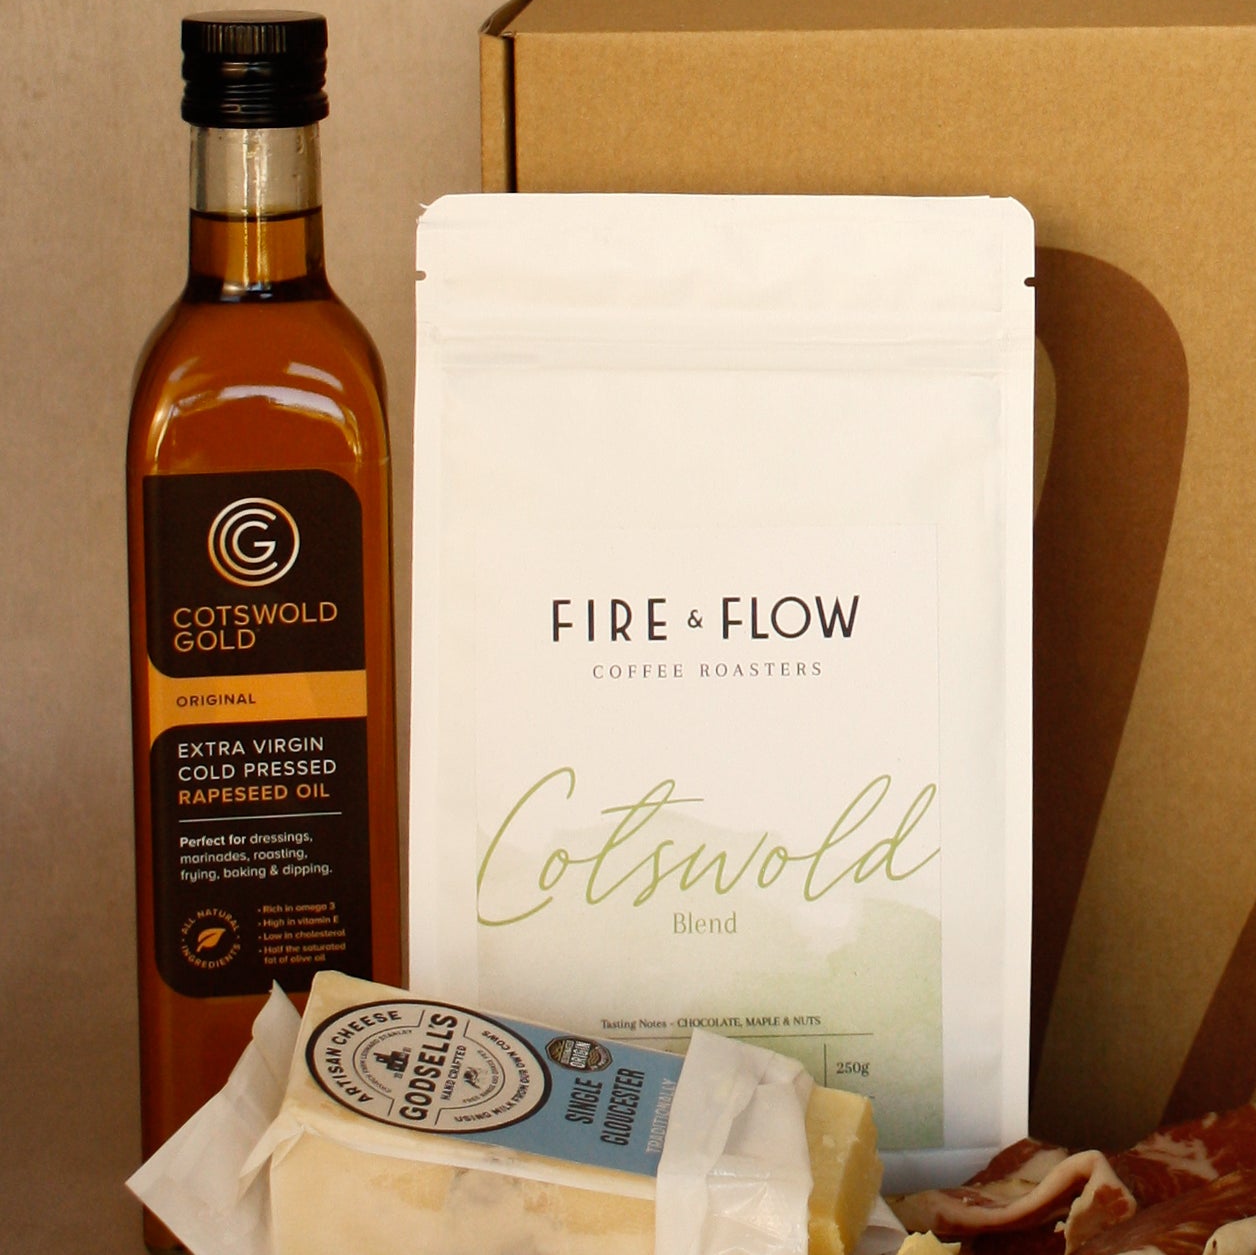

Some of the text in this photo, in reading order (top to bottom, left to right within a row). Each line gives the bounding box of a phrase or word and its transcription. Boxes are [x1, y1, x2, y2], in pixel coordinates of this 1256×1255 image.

[173, 601, 338, 629] COTSWOLD
[552, 594, 860, 642] FIRE & FLOW
[174, 629, 256, 652] GOLD
[592, 661, 822, 680] COFFEE ROASTERS
[176, 693, 256, 708] ORIGINAL
[178, 737, 324, 759] EXTRA VIRGIN
[178, 759, 337, 781] COLD PRESSED
[178, 783, 329, 805] RAPESEED OIL
[180, 831, 313, 848] Perfect for dressings,
[477, 766, 941, 927] Cotswold
[180, 847, 308, 865] marinades, roasting,
[181, 863, 333, 882] frying, baking & dipping.
[263, 901, 336, 914] Rich in omega 3
[182, 908, 241, 935] ALL NATURAL
[263, 918, 285, 928] High
[287, 918, 296, 926] in
[297, 916, 331, 926] vitamin
[672, 912, 738, 934] Blend
[263, 928, 346, 940] Low in cholesterol
[181, 943, 241, 969] INGREDIENTS
[264, 942, 346, 955] Half the saturated
[264, 952, 326, 964] fat of olive oil
[601, 1019, 637, 1030] Tasting
[638, 1019, 668, 1030] Notes
[677, 1017, 744, 1029] CHOCOLATE,
[745, 1017, 780, 1028] MAPLE
[782, 1016, 793, 1027] &
[793, 1015, 821, 1027] NUTS
[480, 1029, 510, 1051] COWS
[323, 1009, 403, 1104] ARTISAN CHEESE
[398, 1012, 458, 1122] GODSELL'S
[448, 1044, 467, 1079] CRAFTED
[836, 1060, 870, 1077] 250g
[492, 1100, 515, 1120] MILK
[565, 1077, 603, 1126] SINGLE
[600, 1067, 646, 1146] GLOUCESTER
[454, 1111, 492, 1123] USING
